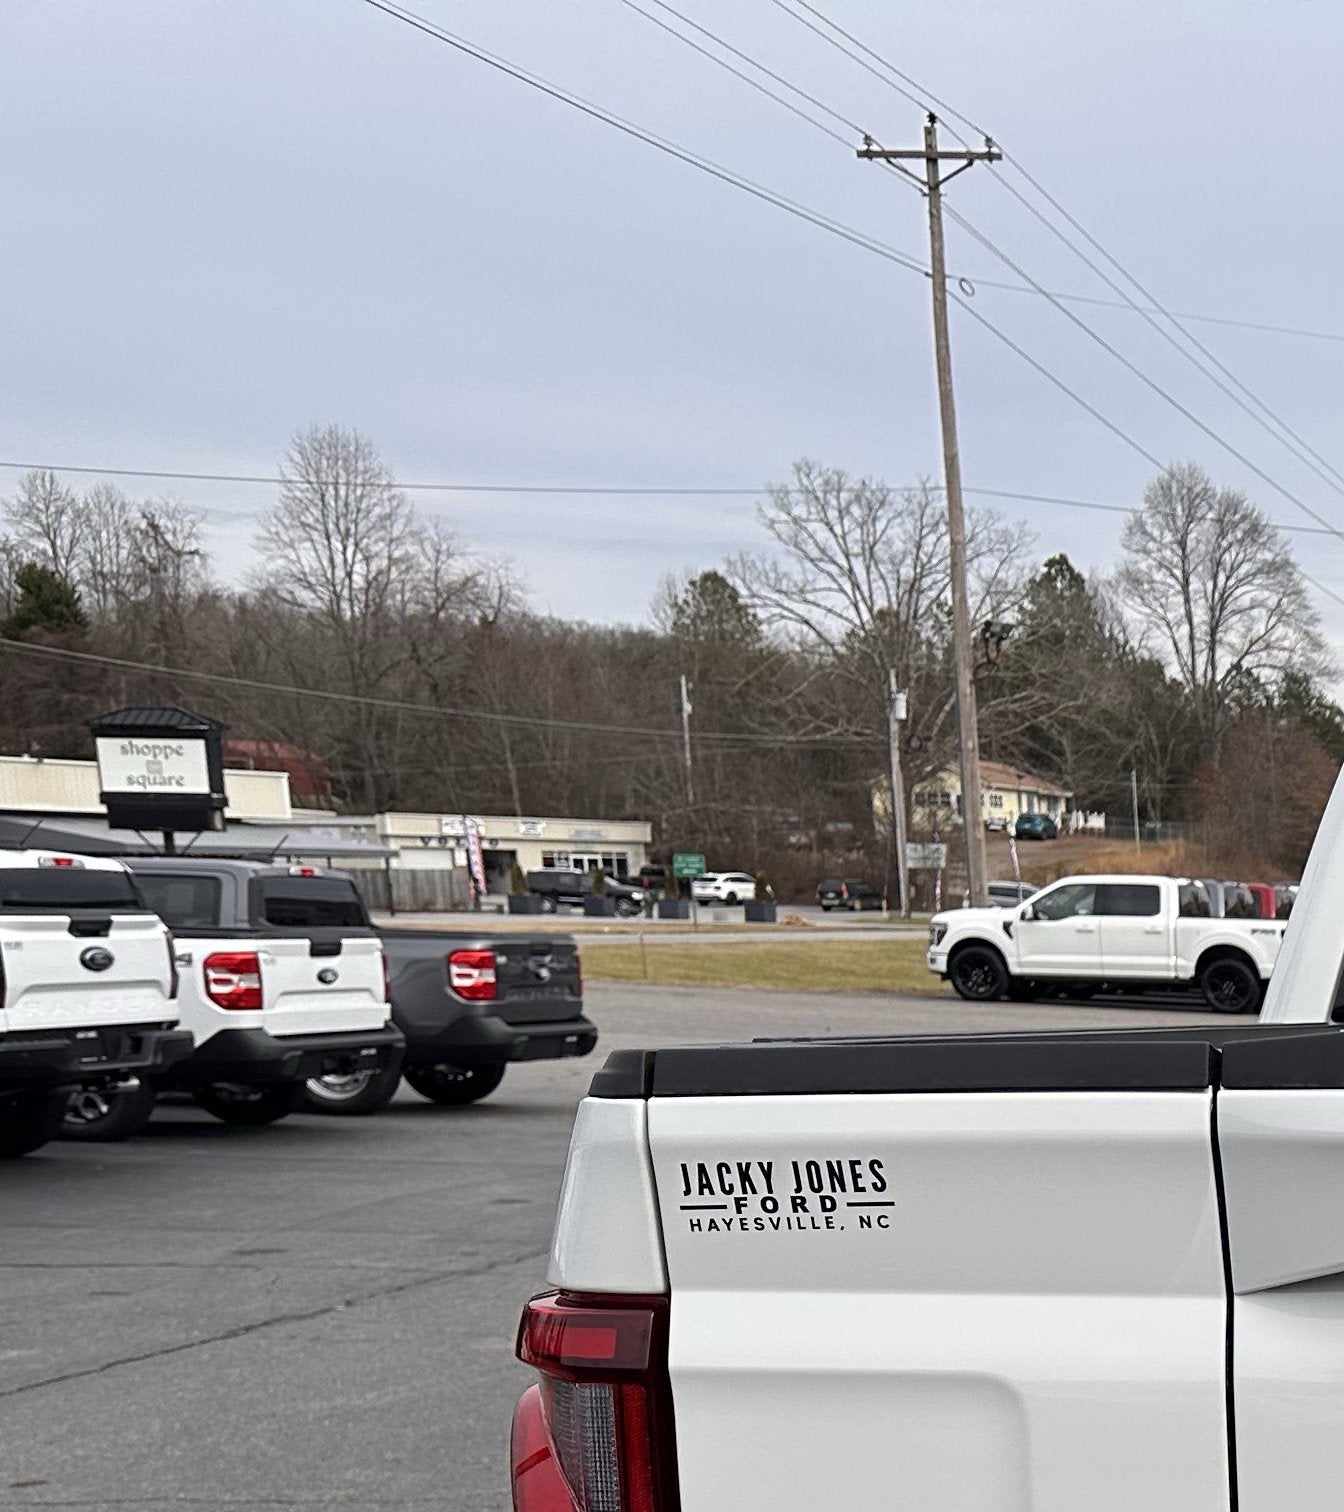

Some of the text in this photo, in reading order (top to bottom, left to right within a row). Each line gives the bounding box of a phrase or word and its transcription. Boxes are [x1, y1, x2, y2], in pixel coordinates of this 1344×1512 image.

[120, 740, 184, 760] shoppe
[126, 774, 184, 789] square
[680, 1159, 887, 1197] JACKY JONES
[733, 1195, 838, 1214] FORD
[689, 1215, 890, 1232] HAYESVILLE, NC
